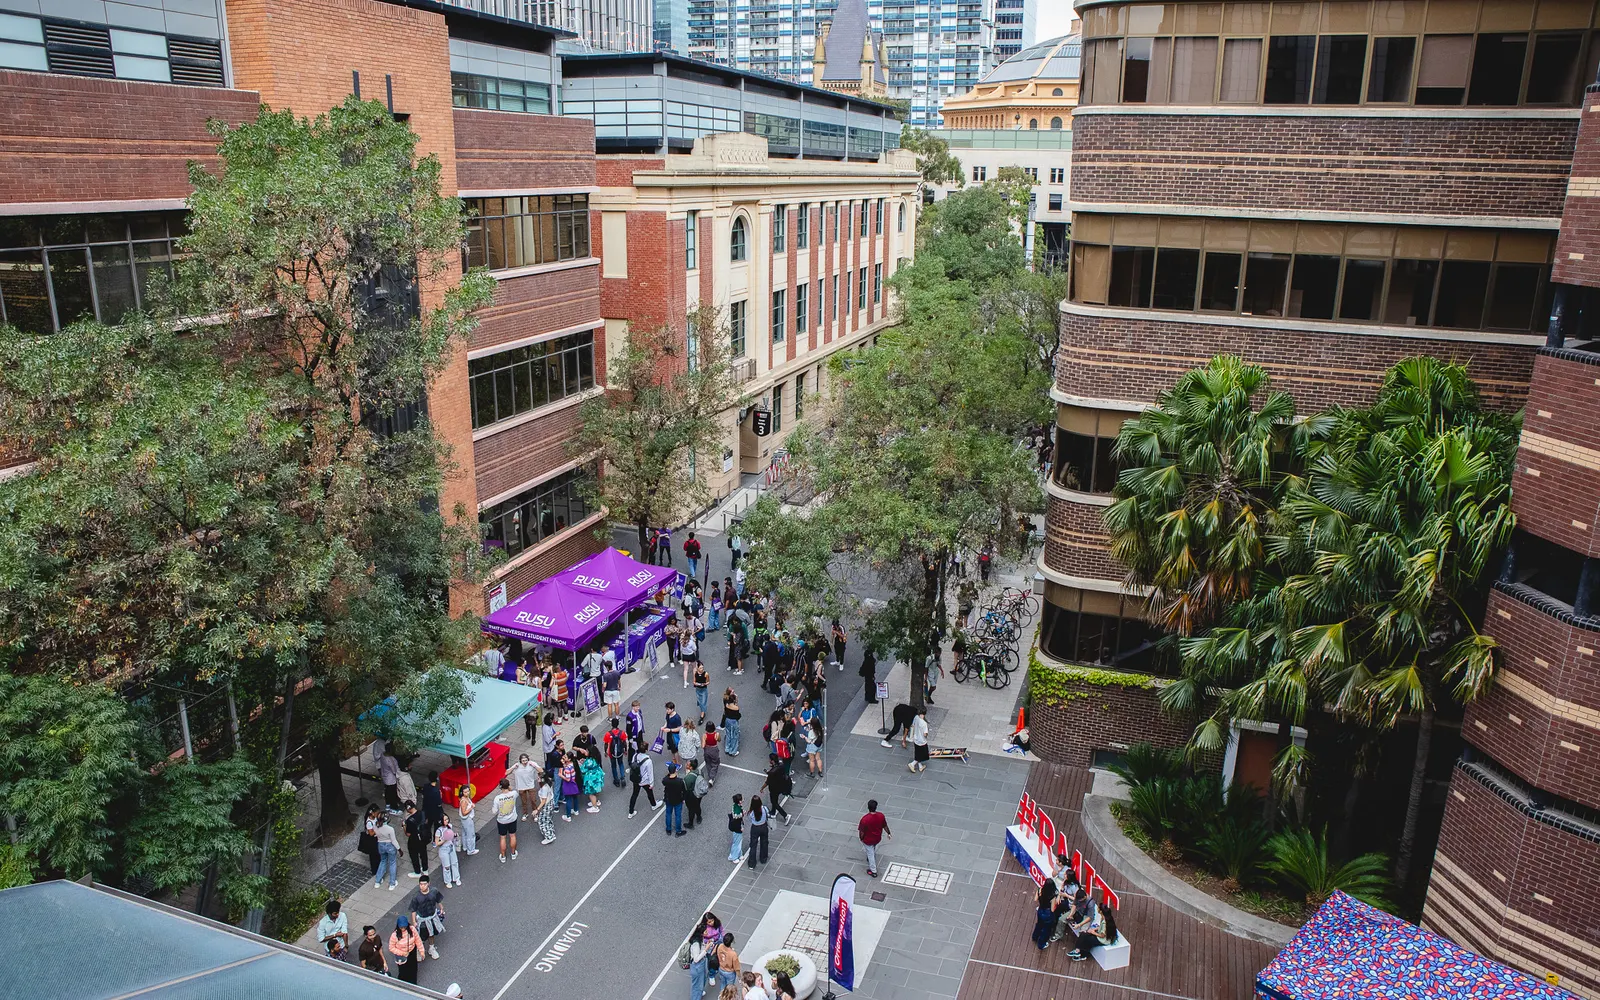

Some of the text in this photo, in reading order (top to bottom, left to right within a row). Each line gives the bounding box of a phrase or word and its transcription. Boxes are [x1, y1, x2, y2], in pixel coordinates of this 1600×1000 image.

[758, 425, 764, 435] 3
[573, 575, 611, 589] RUSU
[627, 569, 653, 586] RUSU
[515, 611, 555, 627] RUSU
[573, 602, 601, 622] RUSU
[527, 632, 549, 642] STUDENT
[549, 636, 567, 646] UNION
[617, 651, 633, 670] RUU
[534, 921, 590, 973] LOADING
